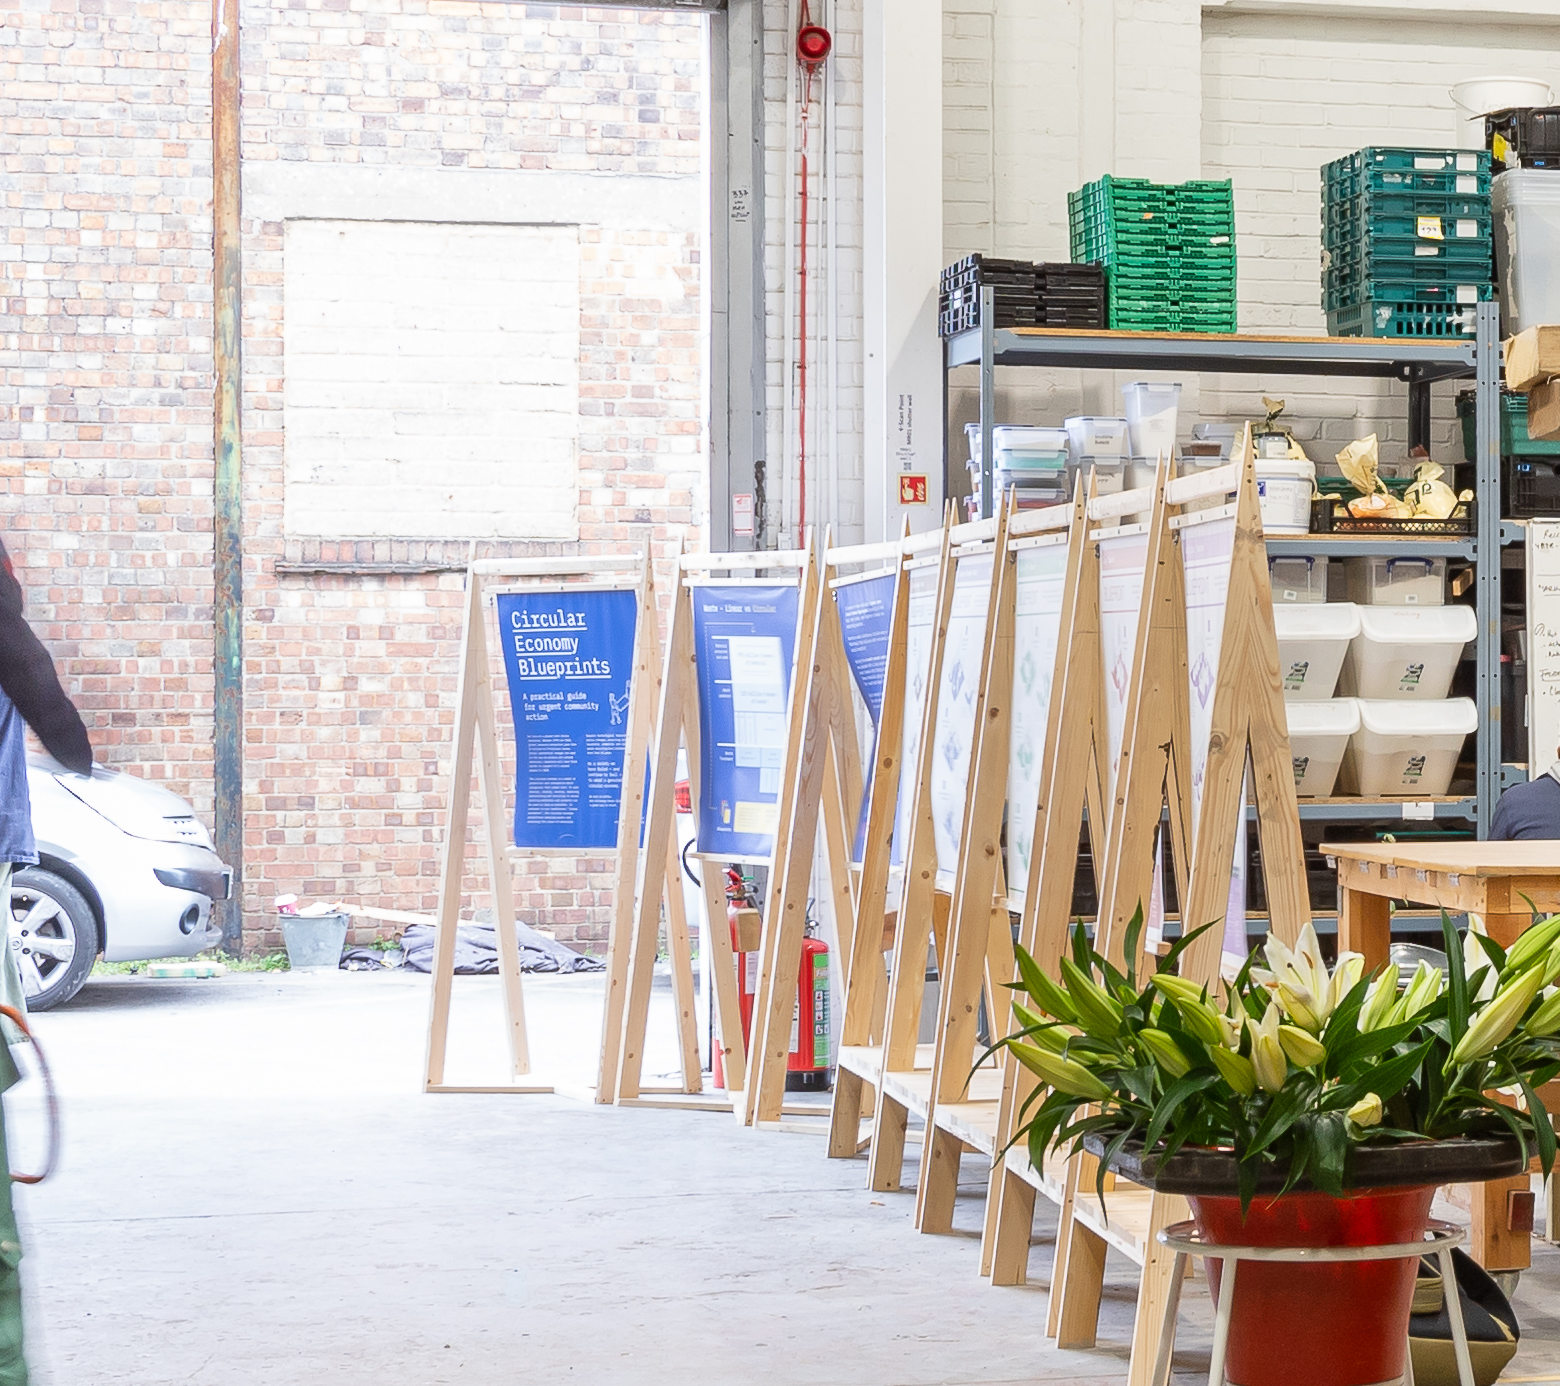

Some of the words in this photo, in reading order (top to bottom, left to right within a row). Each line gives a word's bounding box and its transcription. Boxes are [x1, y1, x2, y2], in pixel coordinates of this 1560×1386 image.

[511, 609, 586, 629] Circular
[514, 635, 579, 655] Economy
[518, 657, 611, 679] Blueprints
